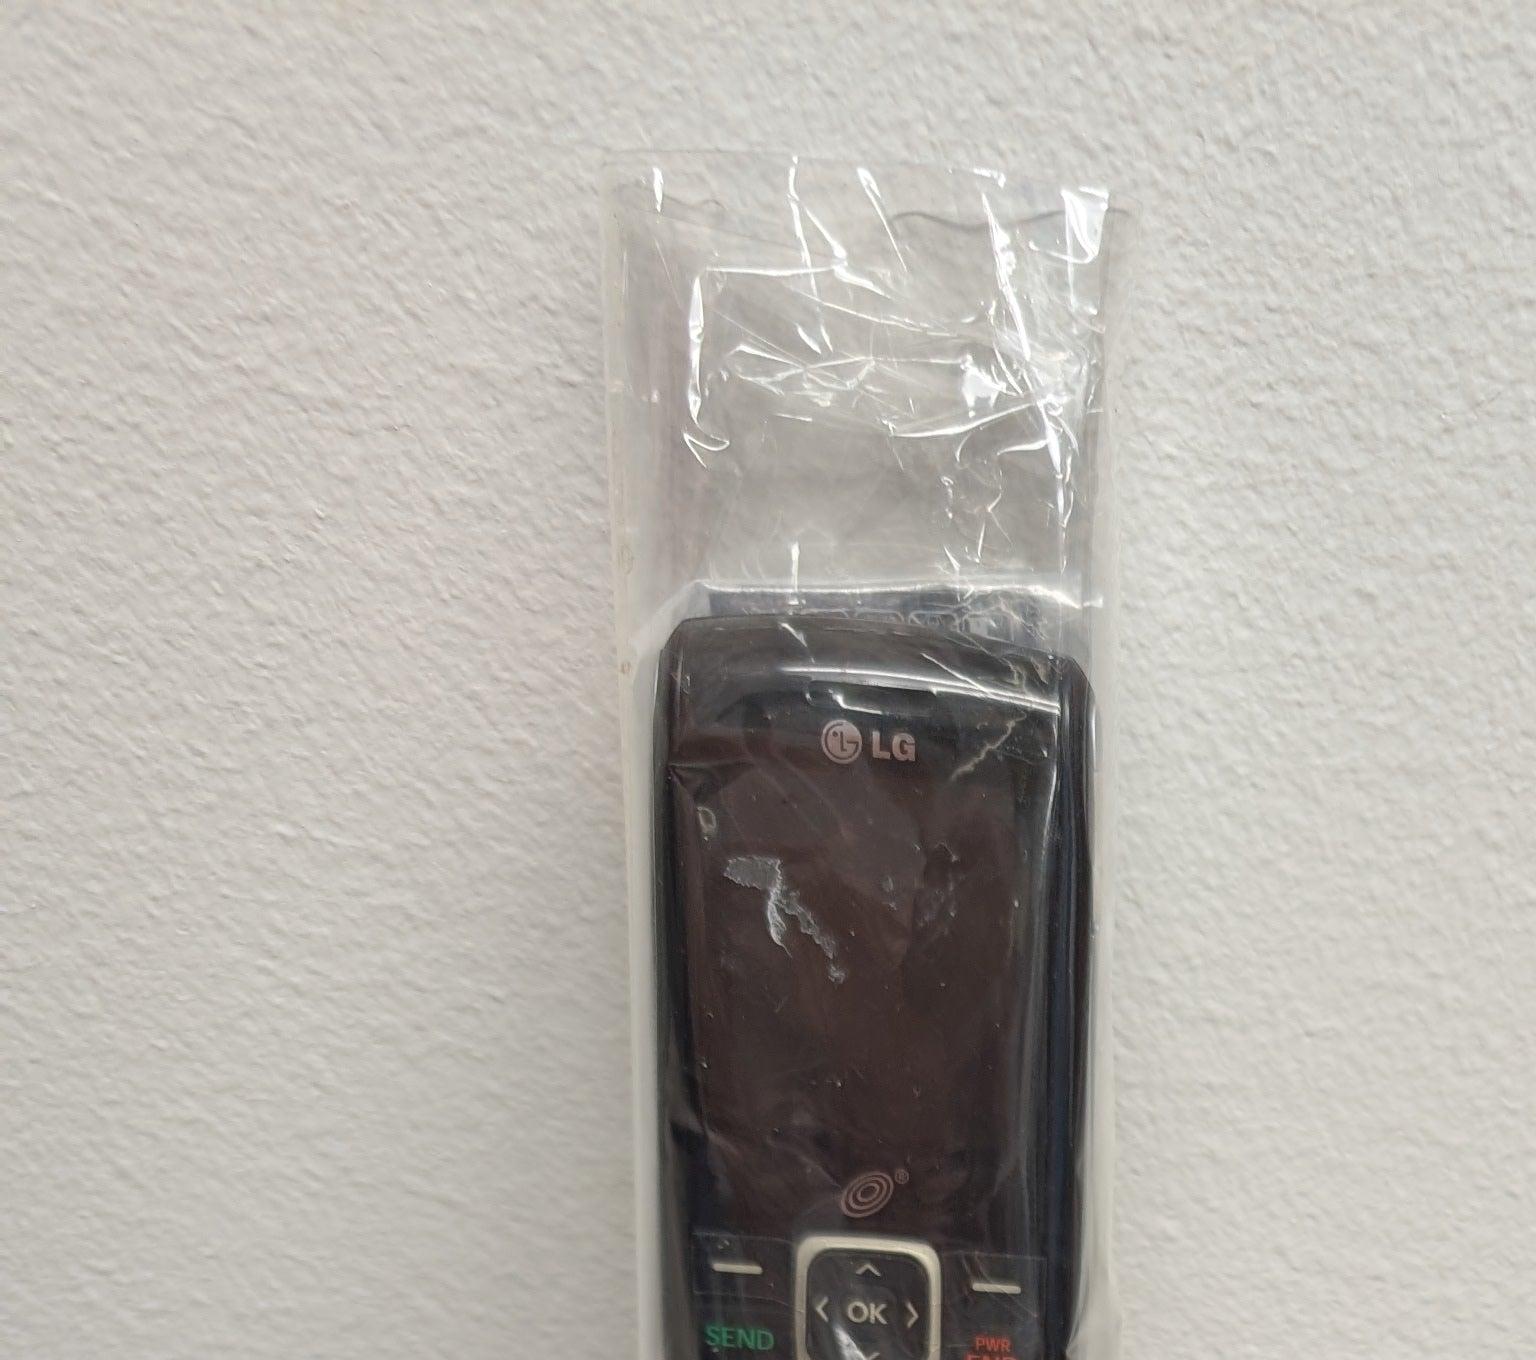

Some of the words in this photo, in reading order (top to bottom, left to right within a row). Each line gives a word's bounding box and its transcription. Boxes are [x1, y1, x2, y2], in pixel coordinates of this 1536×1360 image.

[872, 730, 916, 762] LG
[848, 1302, 887, 1325] OK
[705, 1326, 774, 1351] SEND
[975, 1336, 1011, 1352] PWR
